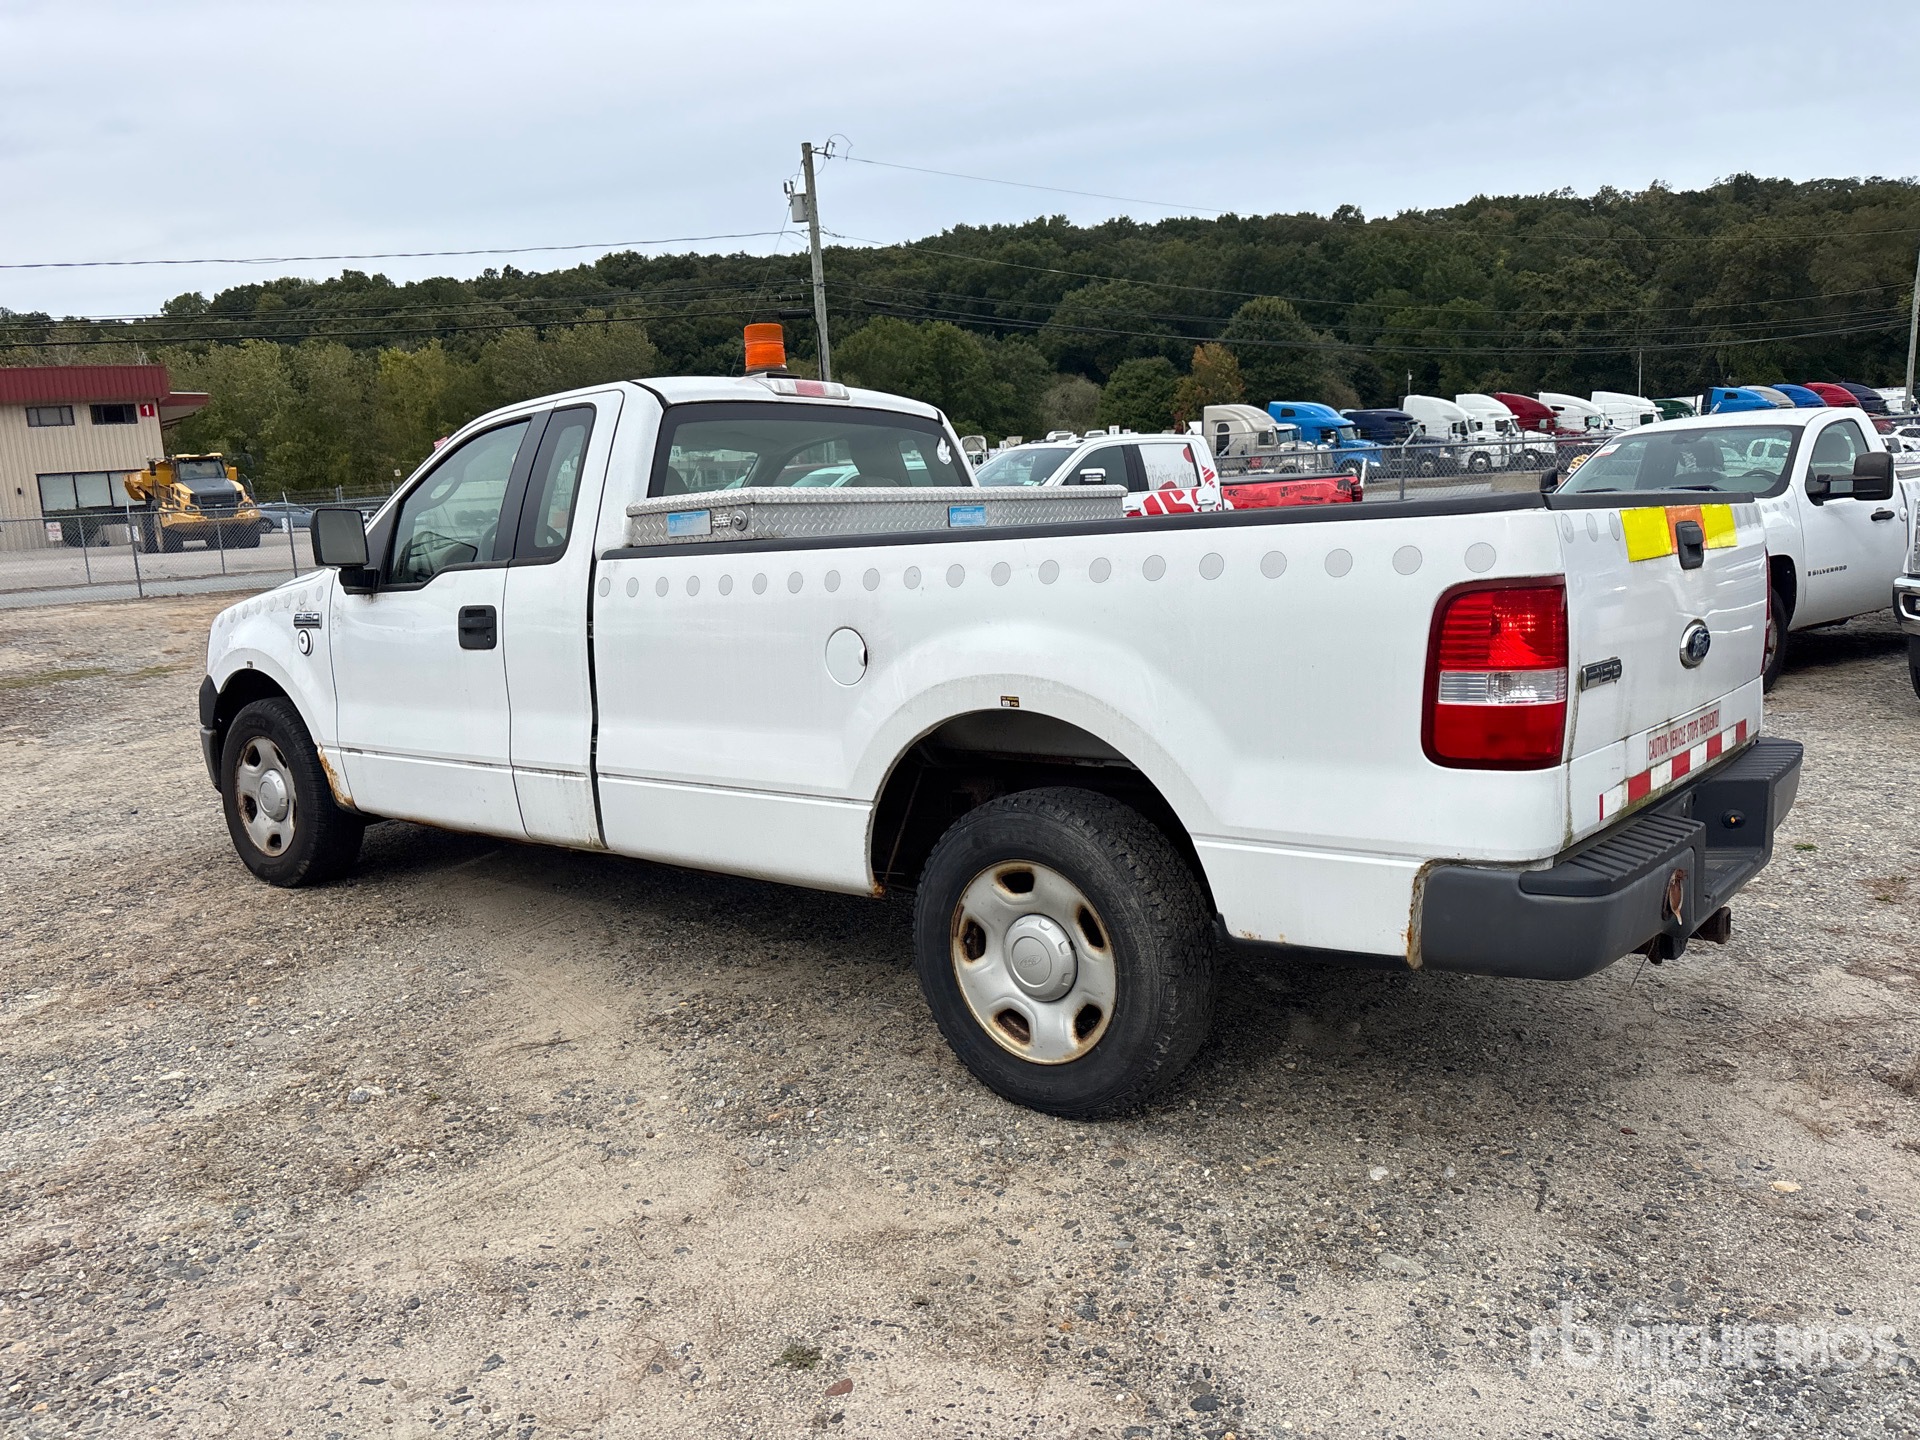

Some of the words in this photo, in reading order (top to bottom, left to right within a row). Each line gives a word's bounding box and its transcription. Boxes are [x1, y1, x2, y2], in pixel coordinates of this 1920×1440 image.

[143, 404, 150, 416] 1
[1812, 565, 1847, 576] SILVERADO
[1669, 724, 1687, 751] VEHICLE
[1687, 719, 1699, 743] STOPS
